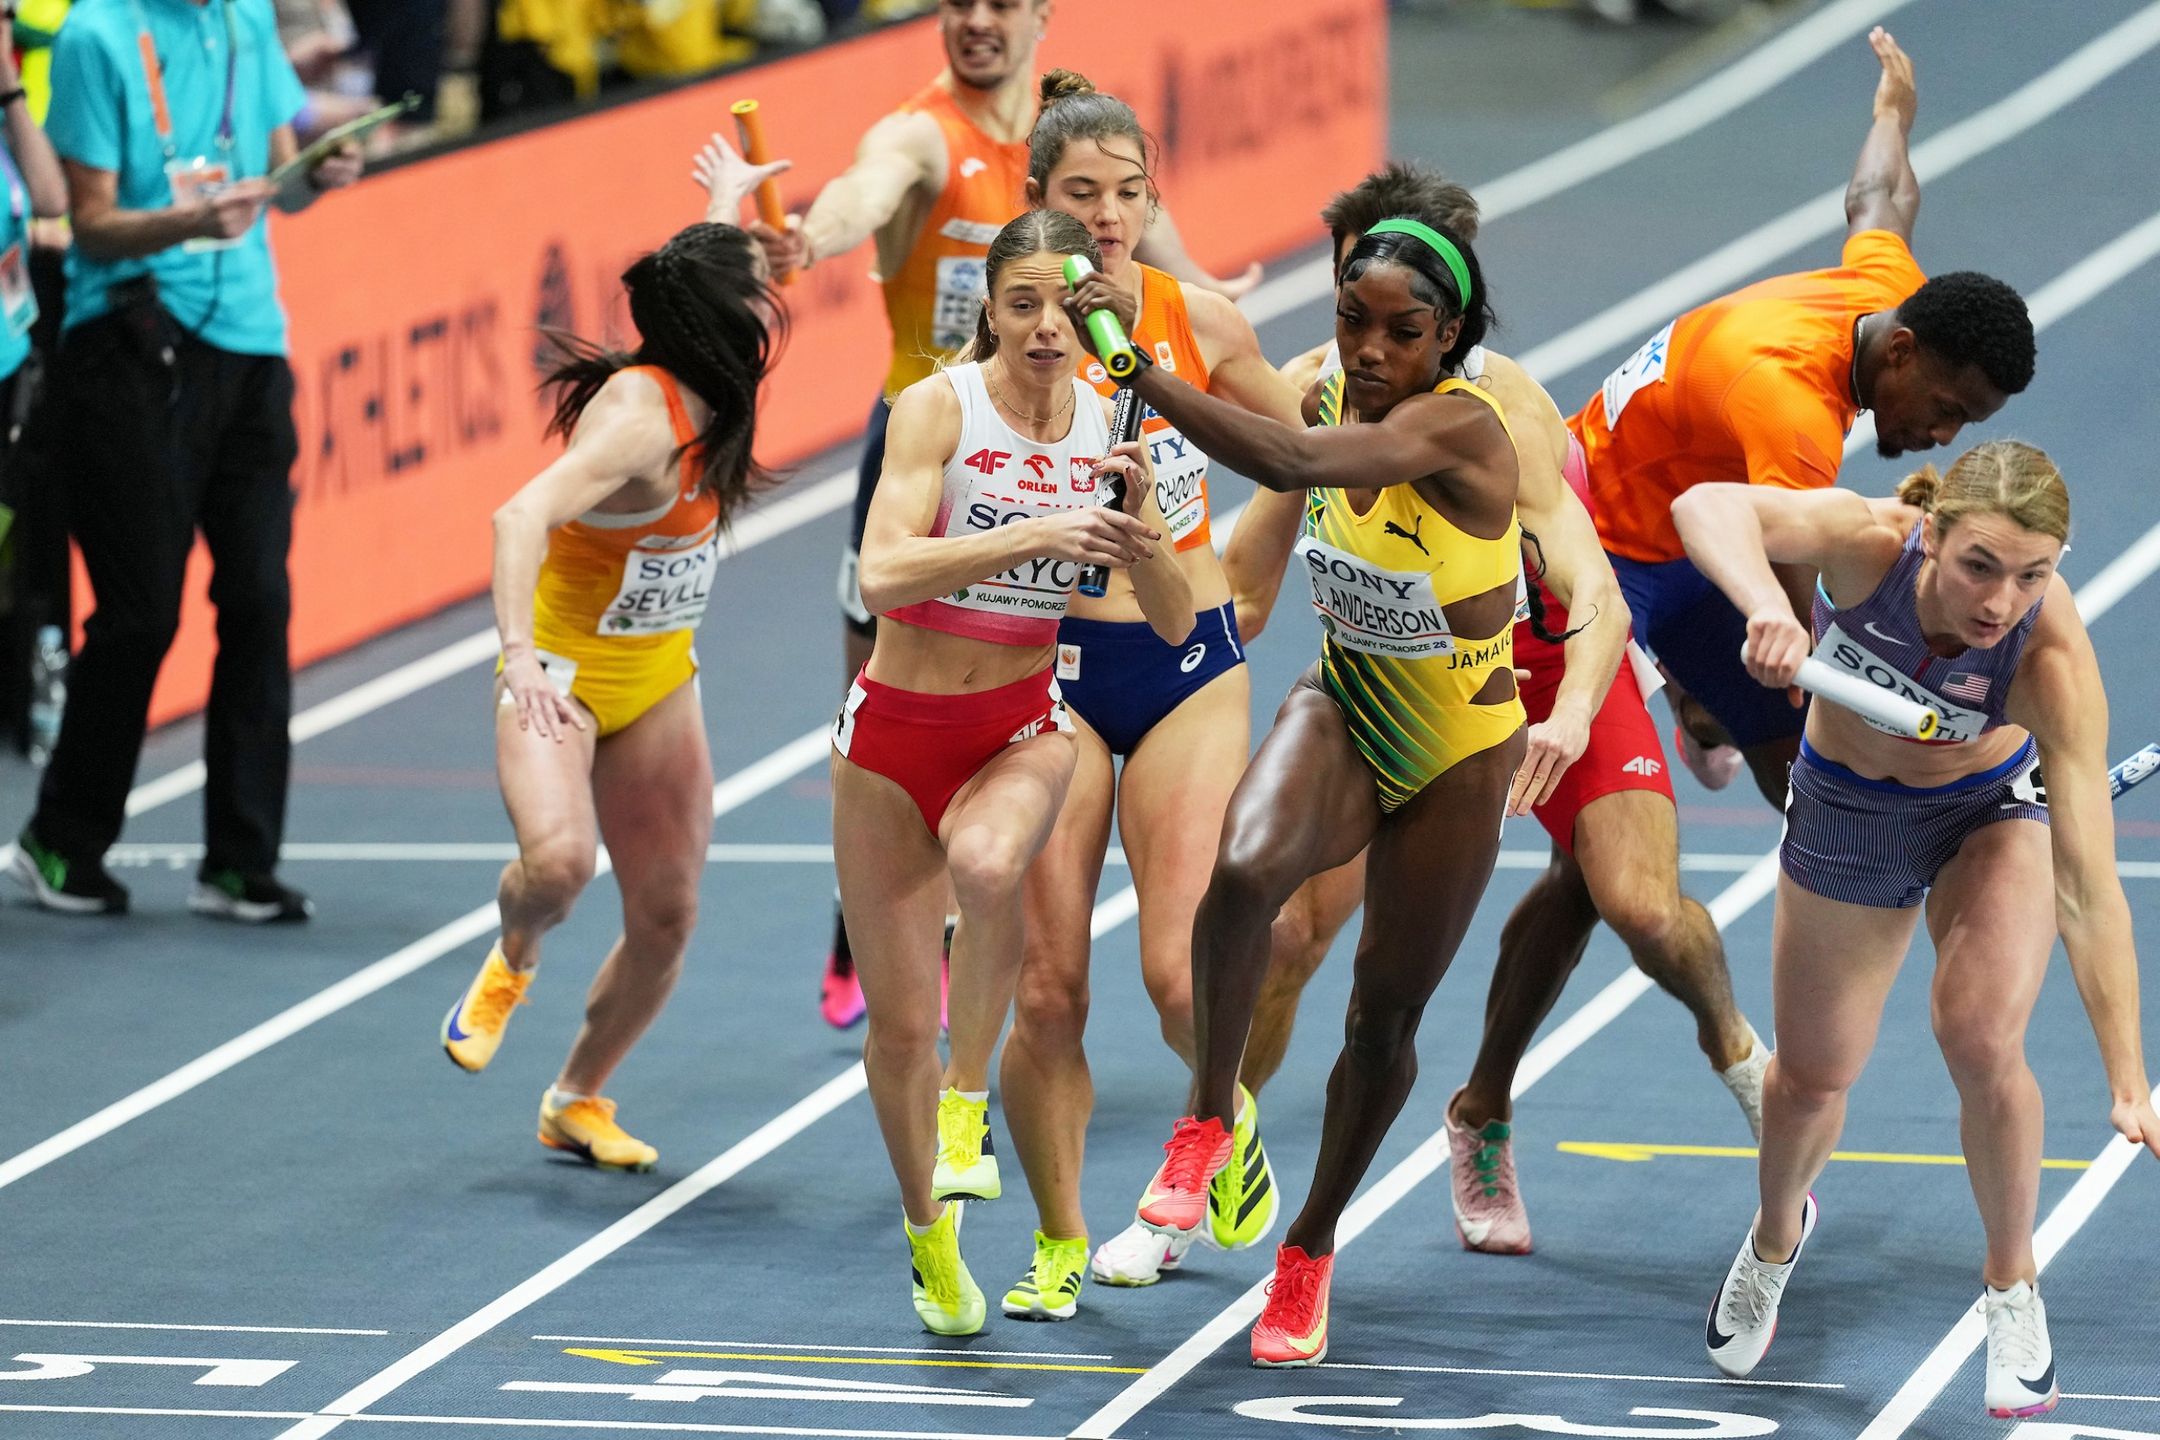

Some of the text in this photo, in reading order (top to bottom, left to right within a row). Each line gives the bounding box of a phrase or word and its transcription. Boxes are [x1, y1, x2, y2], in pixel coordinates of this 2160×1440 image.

[964, 448, 1013, 475] 4F
[1149, 434, 1187, 465] NY
[1017, 479, 1058, 494] ORLEN
[1306, 549, 1416, 600] SONY
[976, 592, 1068, 611] KUJAWY POMORZE
[1329, 586, 1441, 635] ANDERSON
[1341, 631, 1448, 653] KUJAWY POMORZE 26
[1447, 628, 1512, 670] JAMAIC
[1833, 643, 1970, 724] SONY
[1622, 755, 1662, 777] 4F
